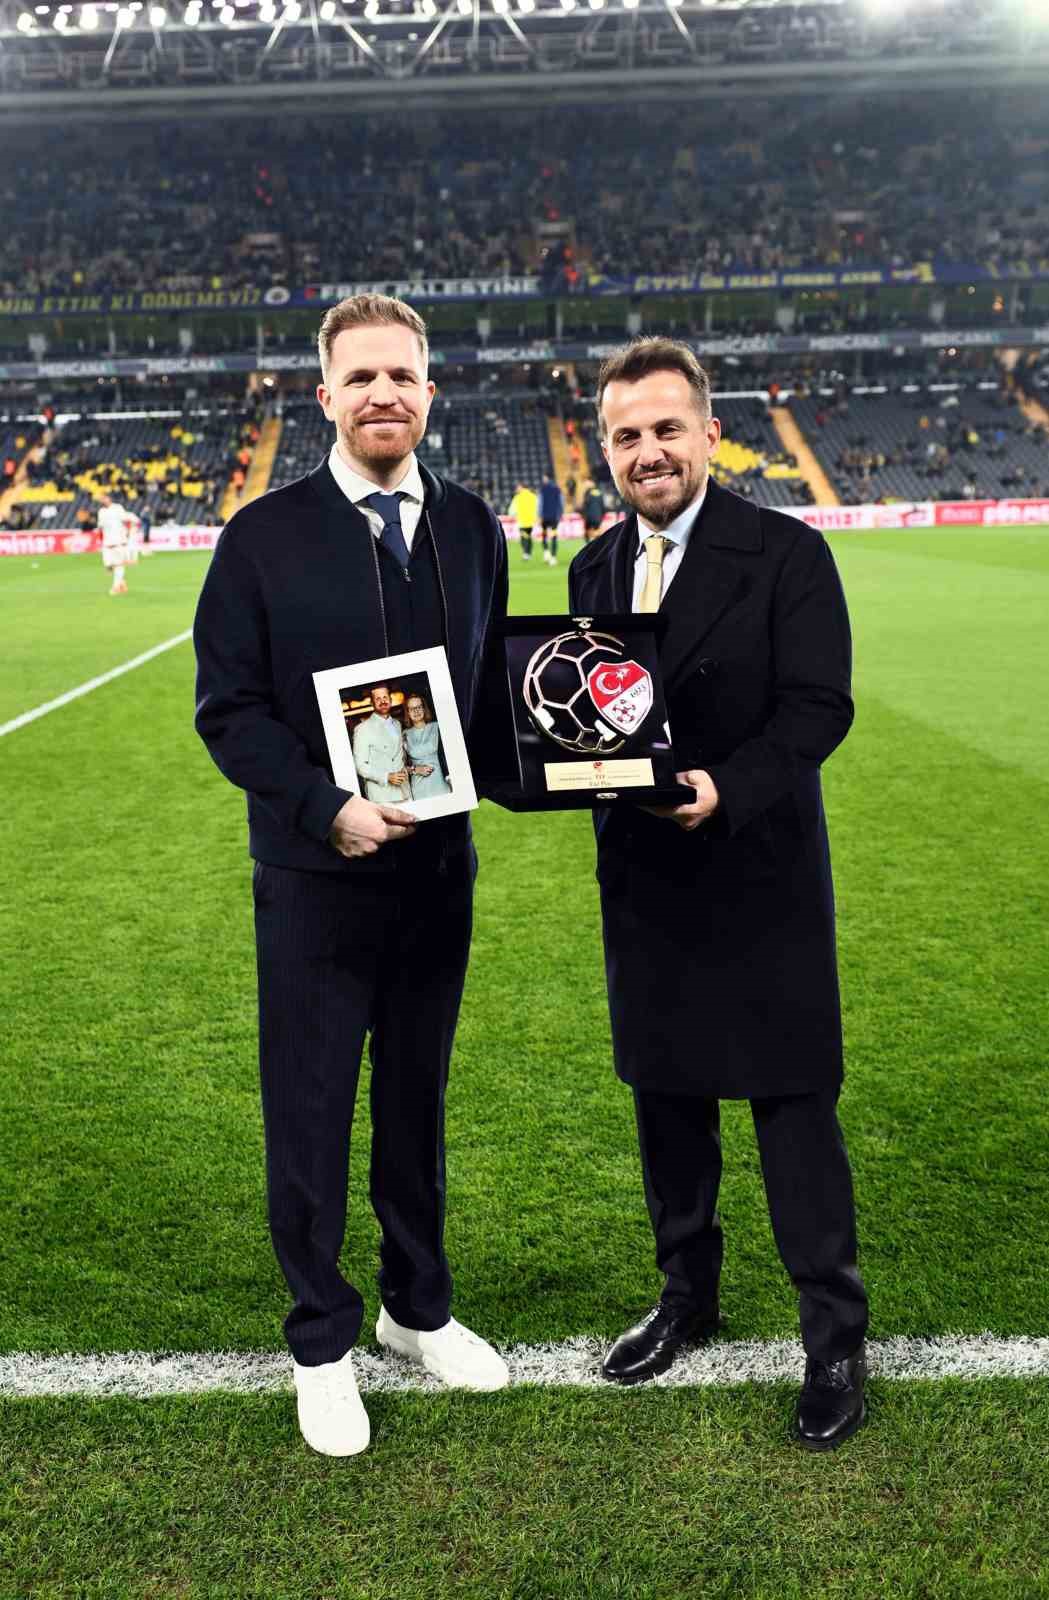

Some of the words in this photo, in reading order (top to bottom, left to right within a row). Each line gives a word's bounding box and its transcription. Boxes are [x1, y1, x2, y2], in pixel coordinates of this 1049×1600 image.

[321, 284, 385, 300] FREE
[809, 335, 881, 351] MEDICANA
[921, 332, 990, 347] MEDICANA
[476, 347, 545, 363] MEDICANA
[38, 361, 106, 377] MEDICANA
[147, 359, 217, 373] MEDICANA
